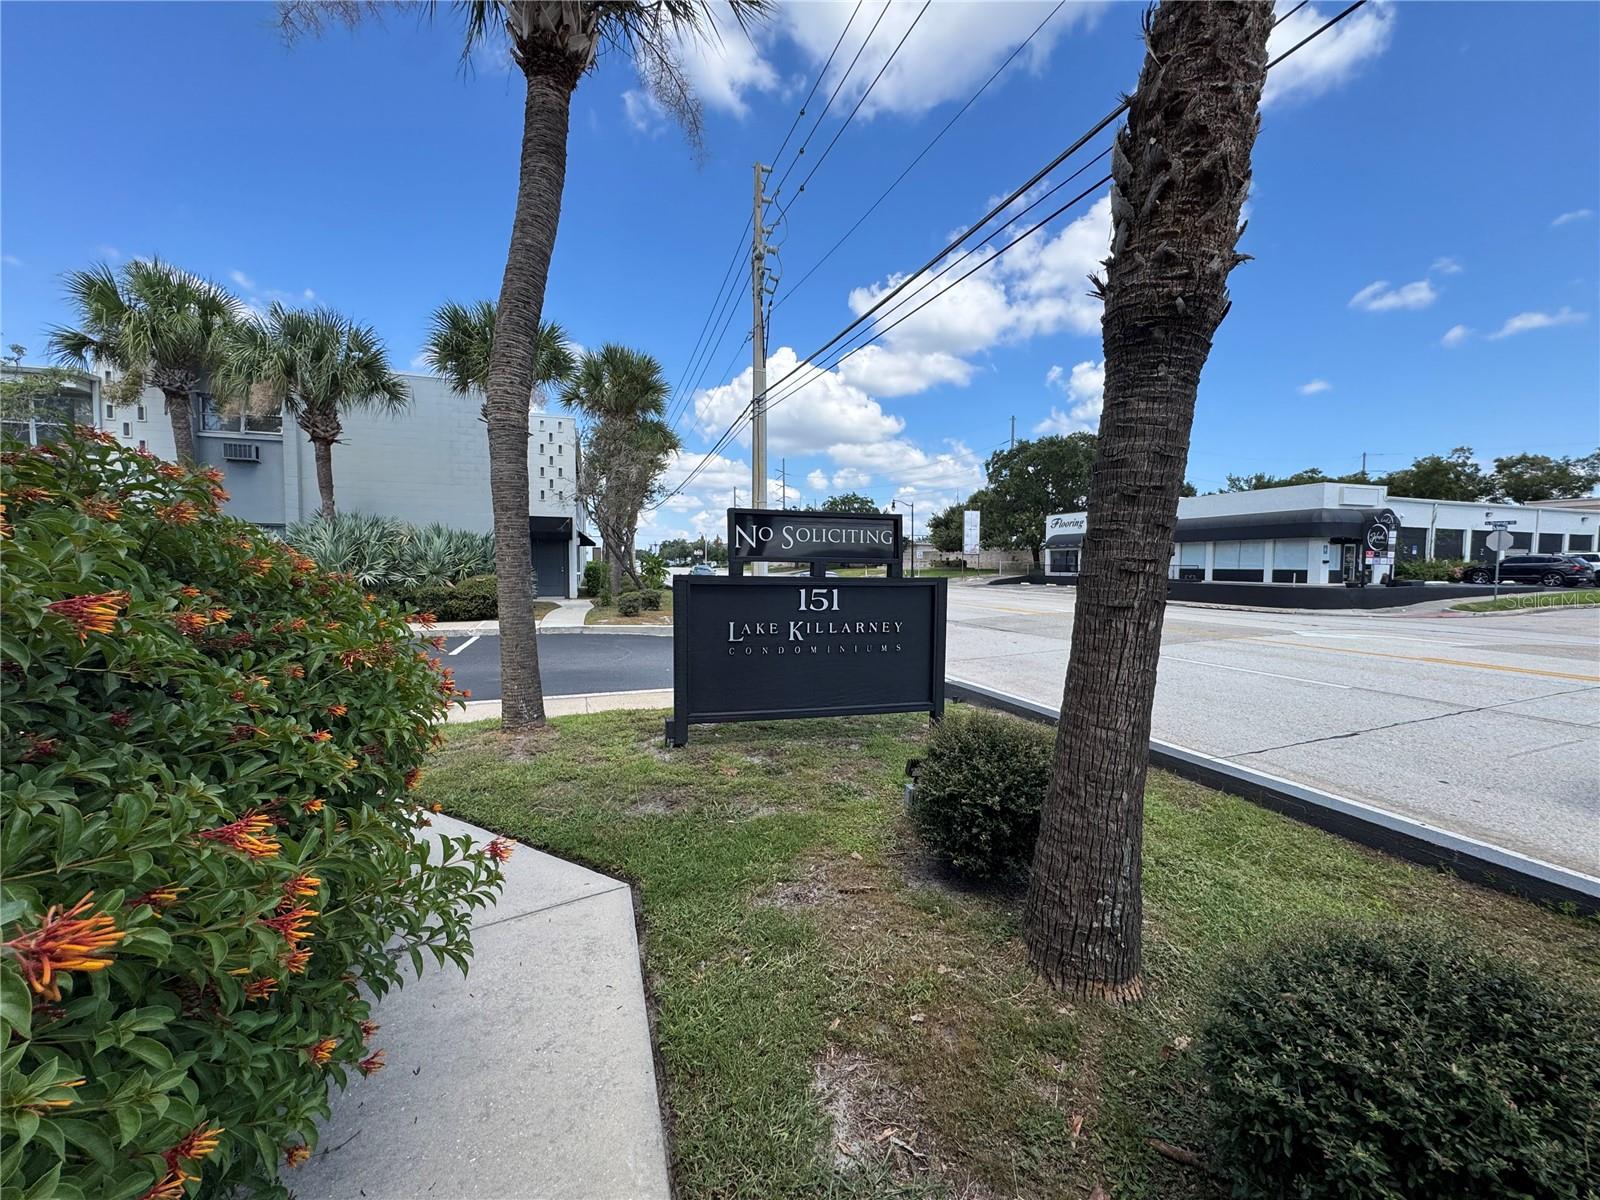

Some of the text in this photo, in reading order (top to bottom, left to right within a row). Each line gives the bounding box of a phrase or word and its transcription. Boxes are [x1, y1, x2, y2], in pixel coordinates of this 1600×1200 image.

[1050, 517, 1085, 529] Flooring
[735, 524, 893, 550] NO SOLICITING
[798, 588, 841, 611] 151
[728, 621, 903, 642] LAKE KILLARNEY
[728, 644, 902, 655] CONDOMINIUMS
